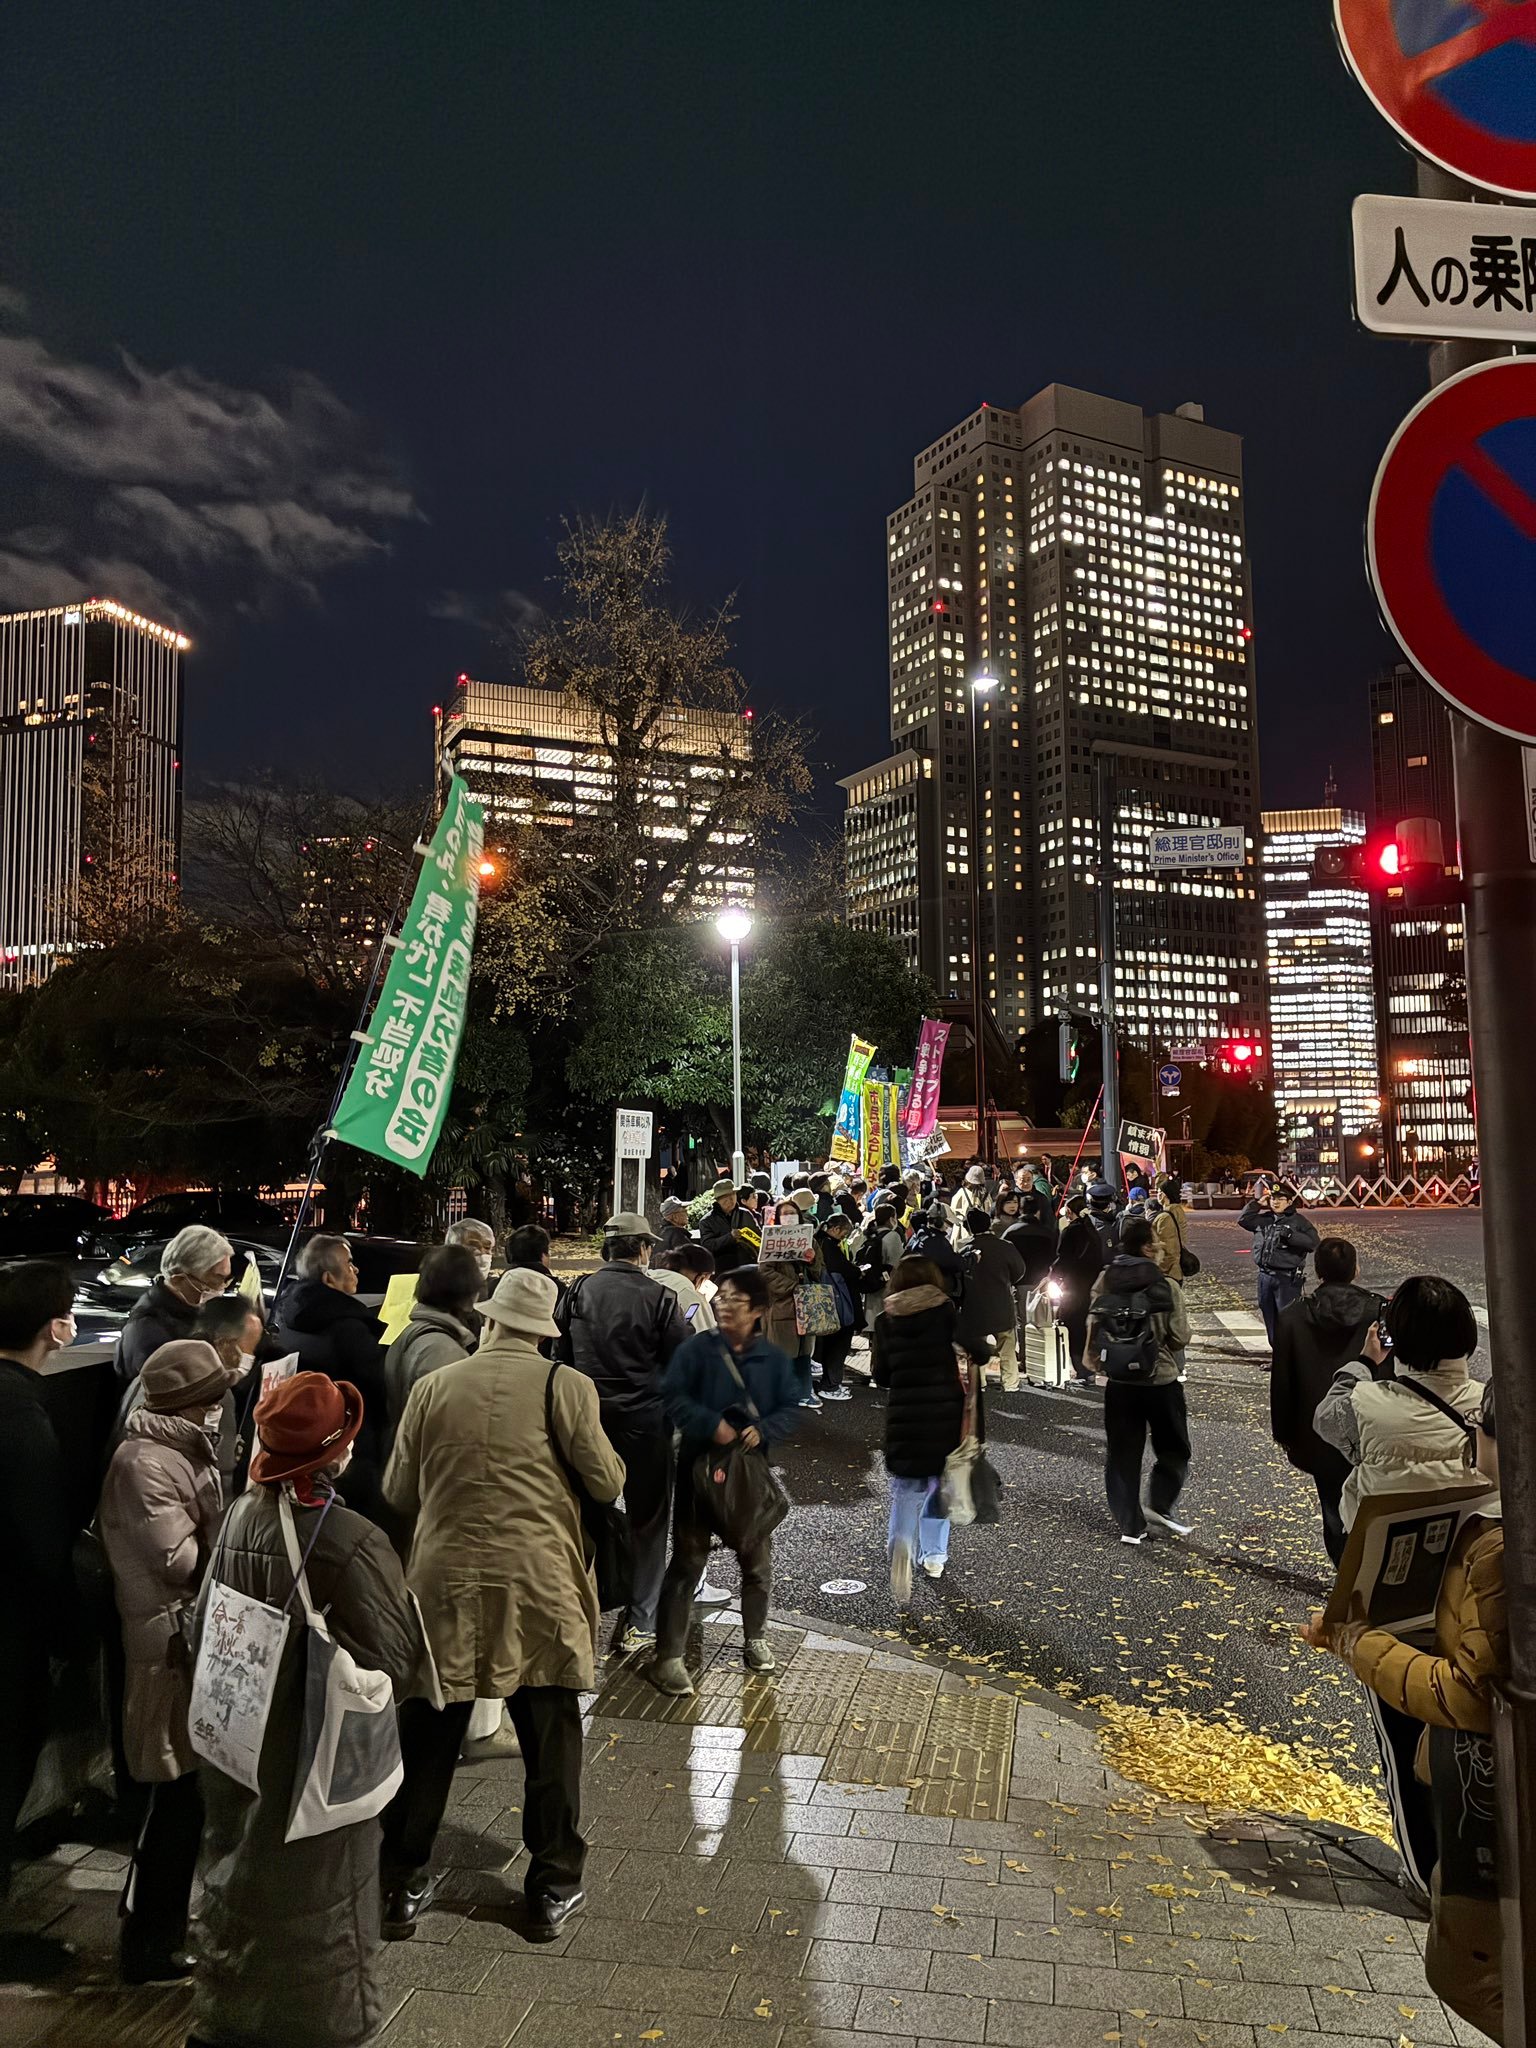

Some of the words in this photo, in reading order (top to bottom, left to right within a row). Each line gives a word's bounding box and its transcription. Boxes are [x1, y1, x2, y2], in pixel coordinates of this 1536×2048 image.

[1155, 834, 1240, 852] 総理官邸前
[1154, 855, 1176, 864] Prime
[1178, 852, 1215, 863] Minister's
[1216, 851, 1240, 861] Office
[765, 1237, 809, 1251] 日中友好
